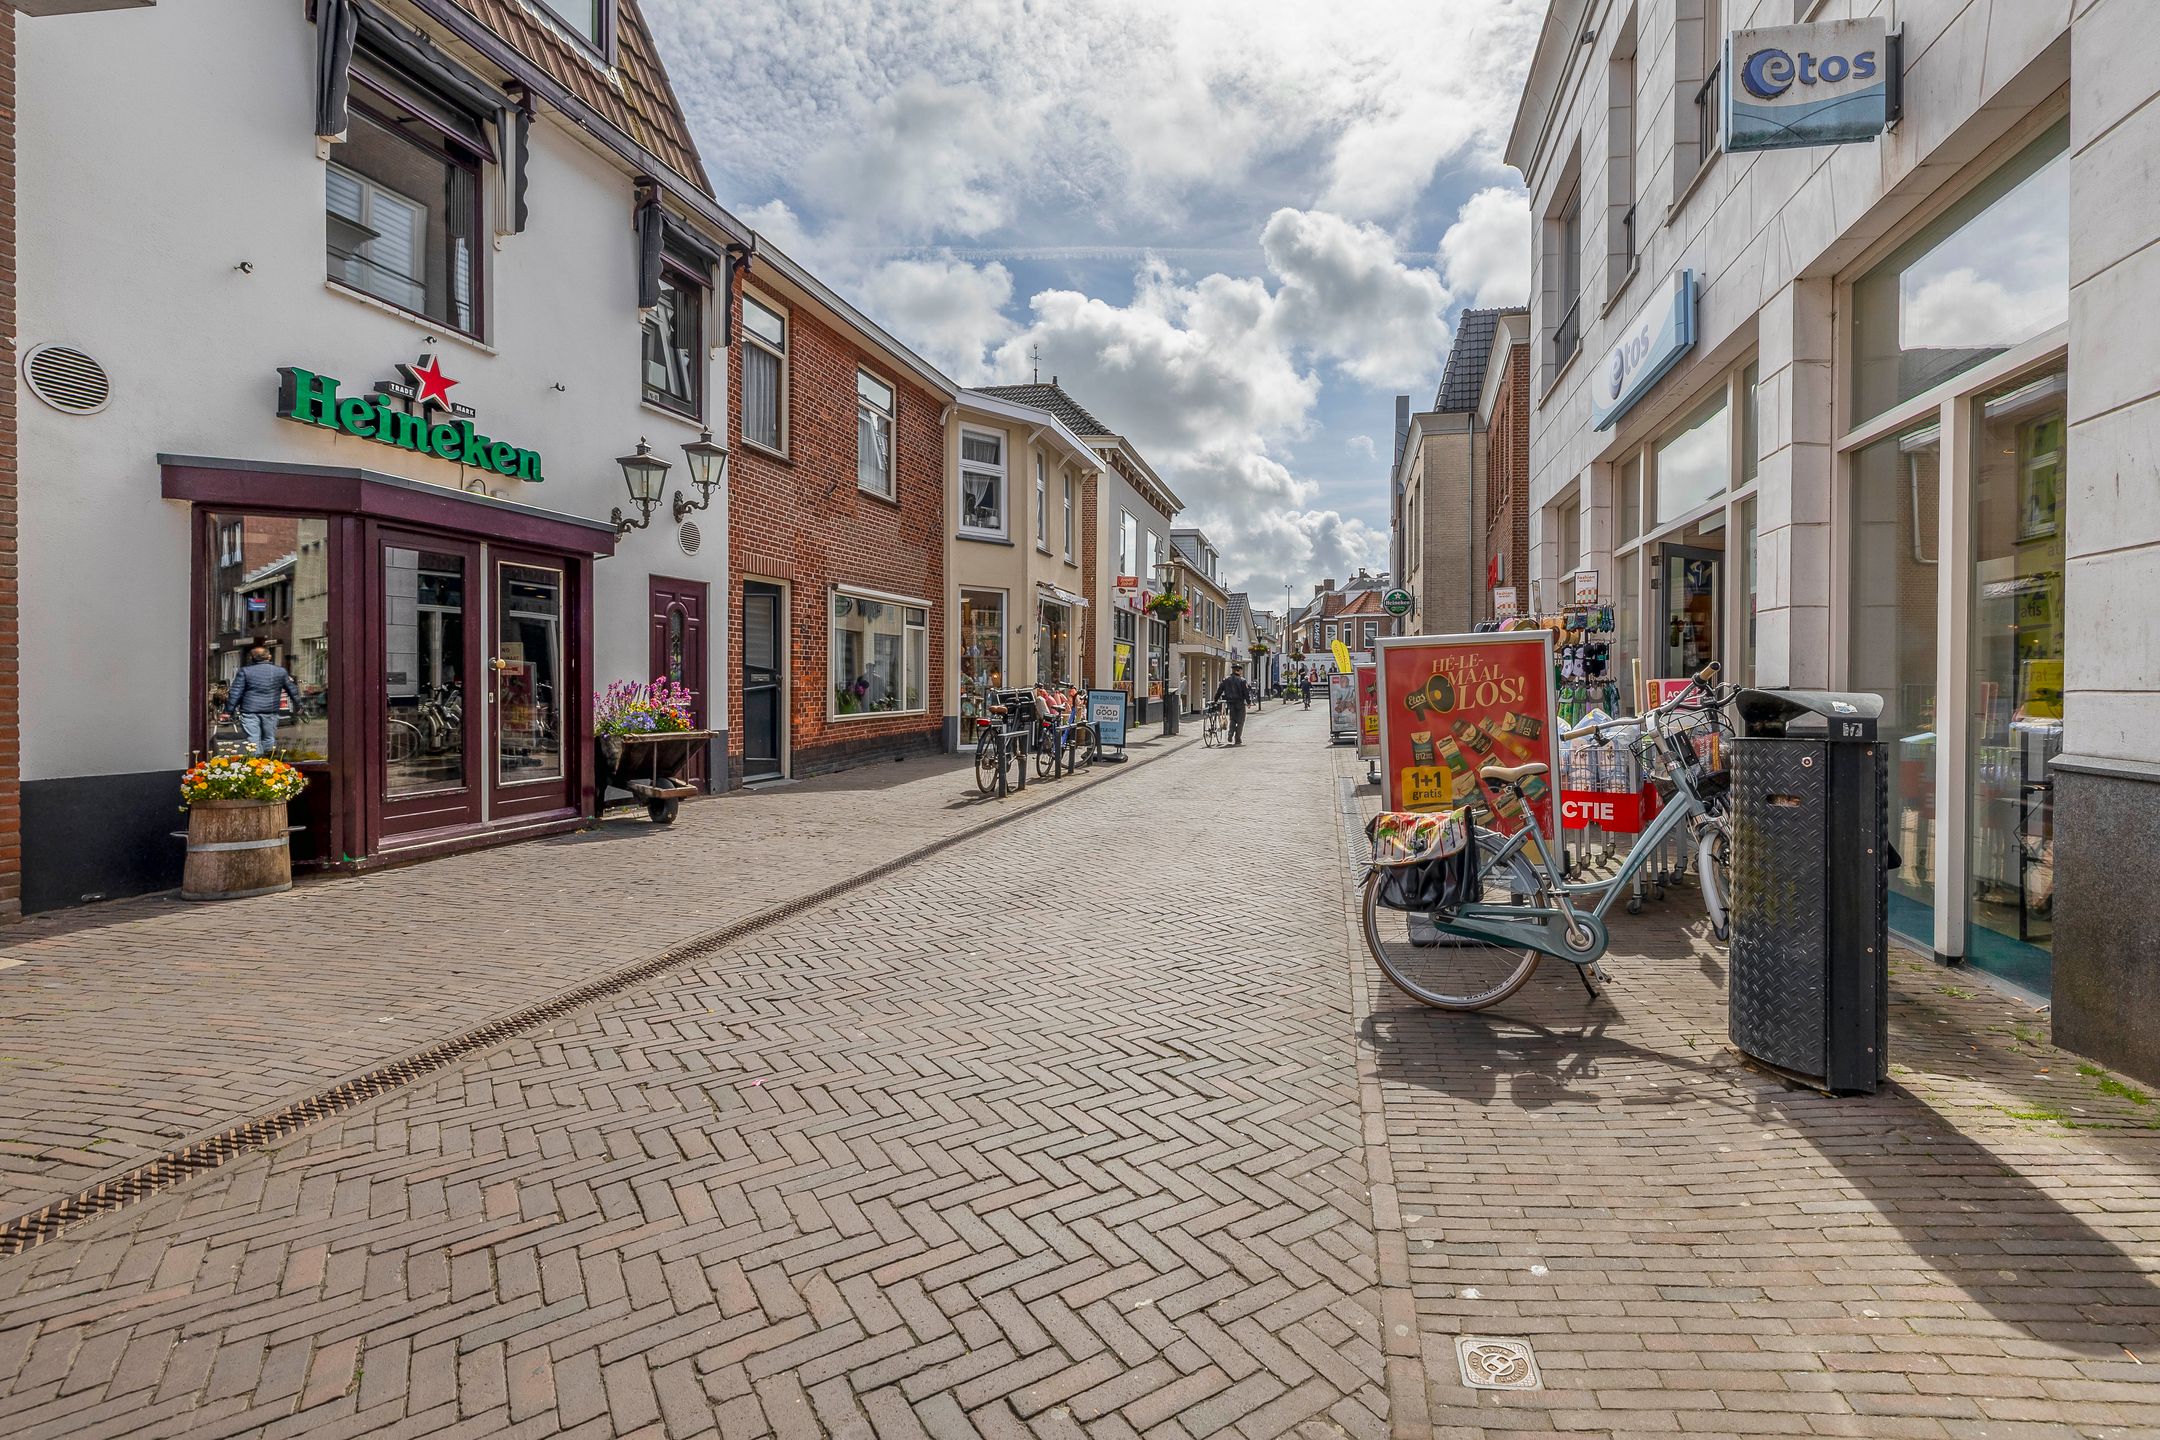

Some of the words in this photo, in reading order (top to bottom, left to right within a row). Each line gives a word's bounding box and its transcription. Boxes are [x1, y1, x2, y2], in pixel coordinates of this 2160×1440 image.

[1741, 49, 1876, 99] etos
[1609, 324, 1650, 400] etos
[391, 383, 414, 396] TRADE
[456, 405, 474, 416] MARK
[279, 367, 545, 483] Heineken
[1432, 653, 1484, 673] HÉ-LE-
[1447, 664, 1503, 686] MAAL
[1408, 693, 1426, 706] Etos
[1457, 676, 1525, 711] LOS!
[1415, 752, 1426, 761] B12
[1411, 771, 1442, 789] 1+1
[1412, 787, 1442, 801] gratis
[1562, 801, 1614, 820] CTIE
